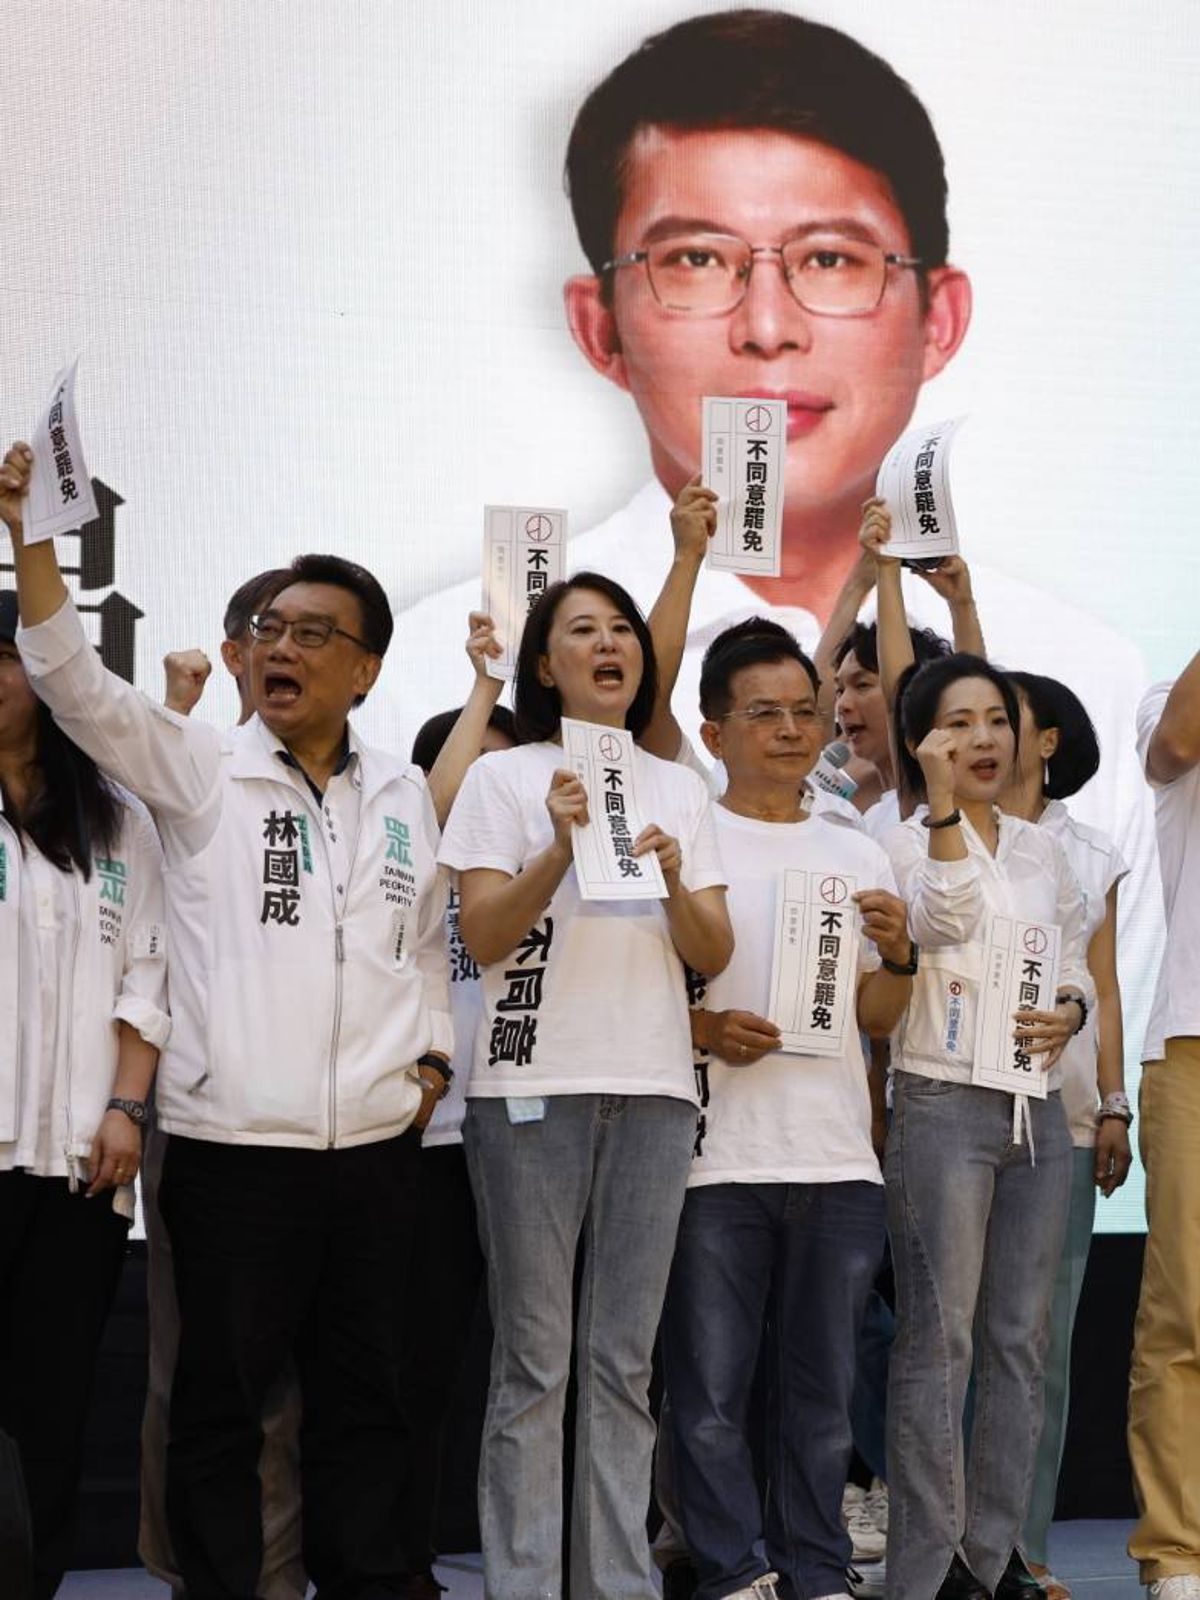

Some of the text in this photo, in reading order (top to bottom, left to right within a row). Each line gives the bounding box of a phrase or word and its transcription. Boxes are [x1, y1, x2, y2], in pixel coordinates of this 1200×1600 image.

[49, 381, 79, 505] 同意罷免
[743, 439, 768, 552] 不同意罷免
[913, 436, 941, 535] 不同意罷免
[261, 810, 301, 926] 林國成
[604, 767, 643, 878] 不同意罷免
[811, 910, 843, 1030] 不同意罷免
